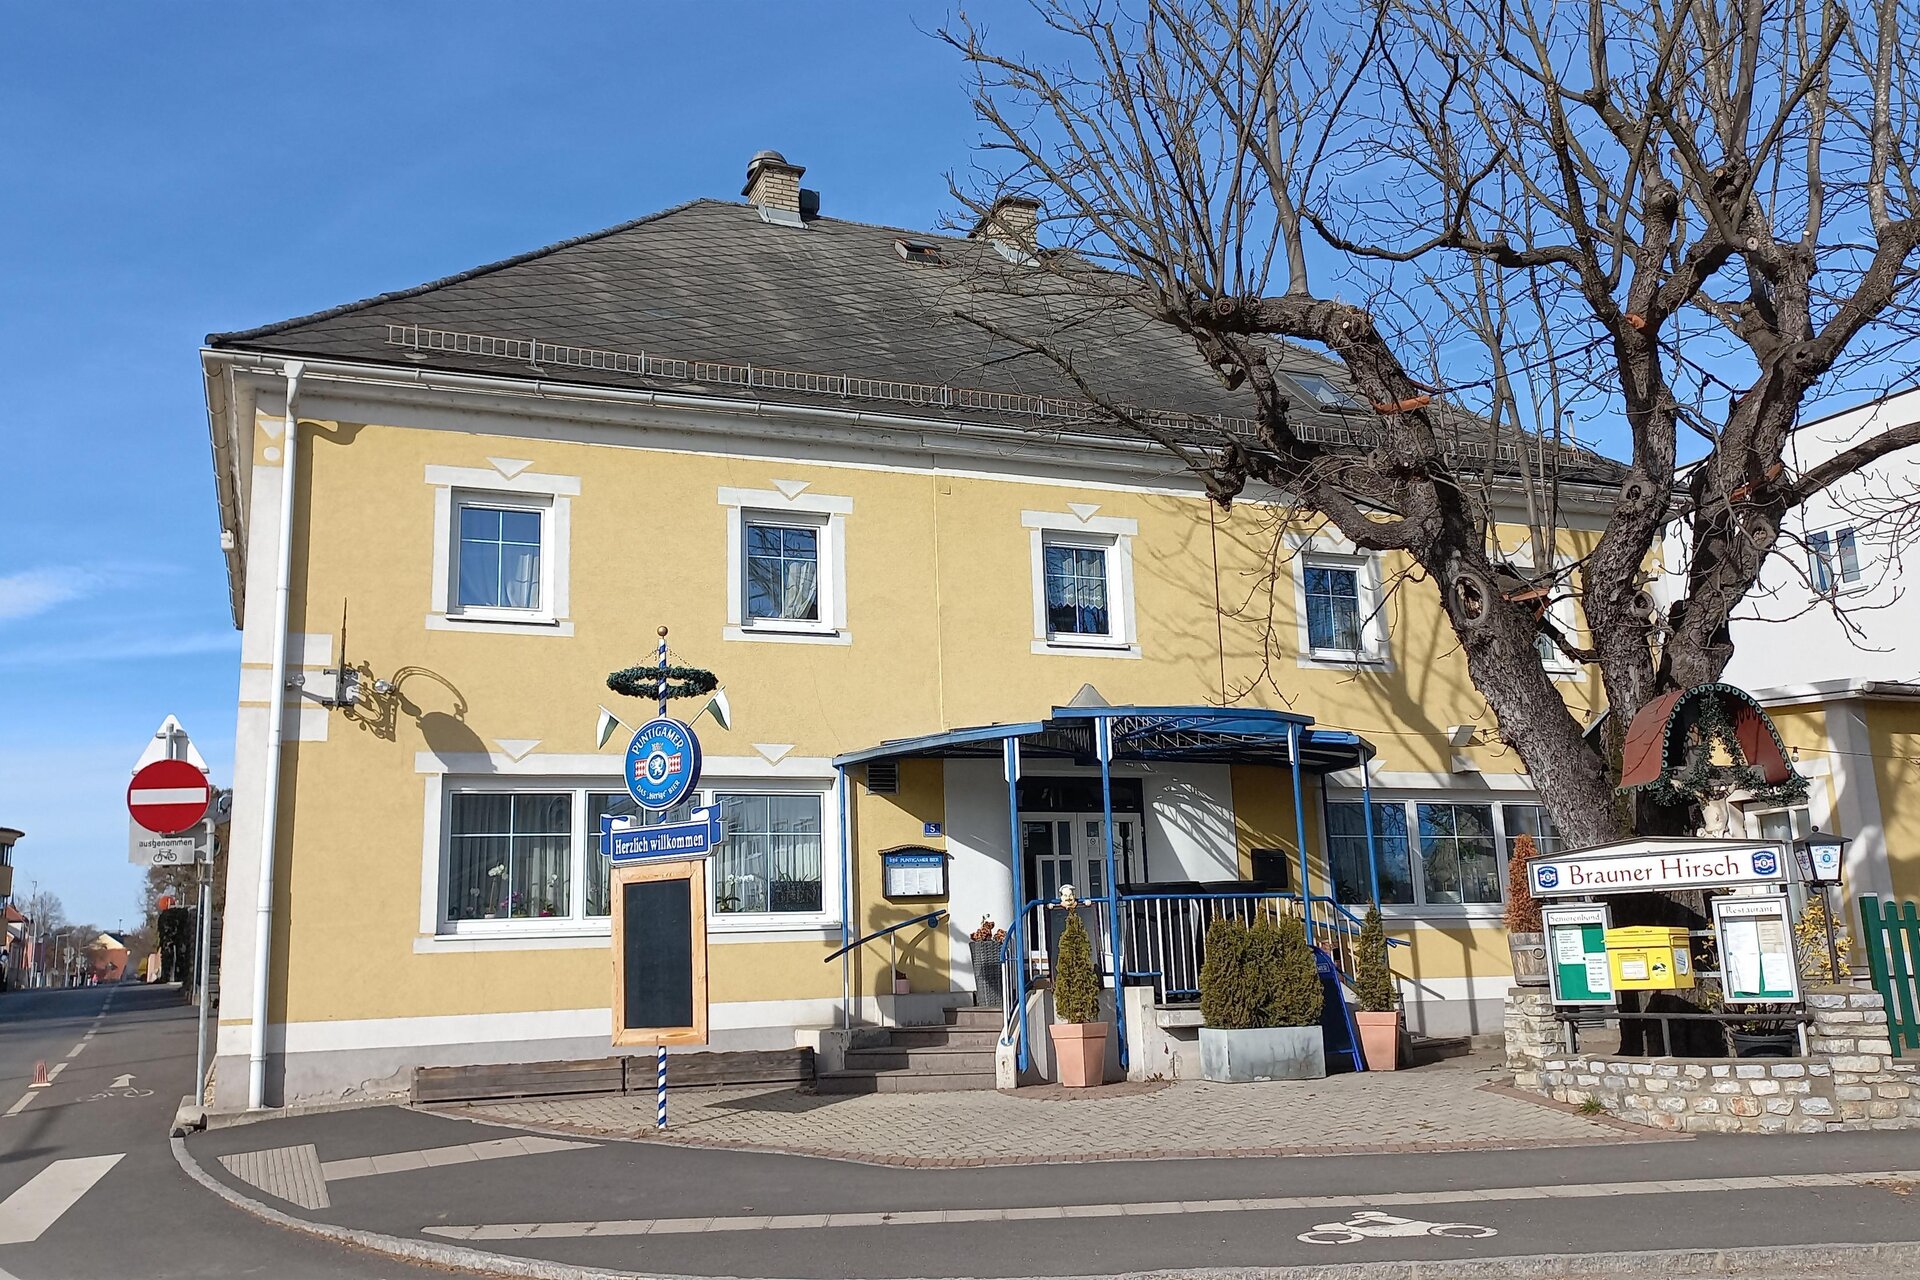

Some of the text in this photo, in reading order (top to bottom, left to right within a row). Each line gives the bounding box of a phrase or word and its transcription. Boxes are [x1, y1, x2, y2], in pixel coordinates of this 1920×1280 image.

[631, 726, 684, 755] PUNTIGAMER
[636, 784, 647, 797] DAS
[668, 779, 681, 795] BIER
[929, 823, 936, 833] 5
[138, 839, 192, 849] ausgenommen
[615, 834, 704, 855] Herzlich willkommen
[1569, 855, 1741, 885] Brauner Hirsch
[1725, 905, 1773, 915] Restaurant
